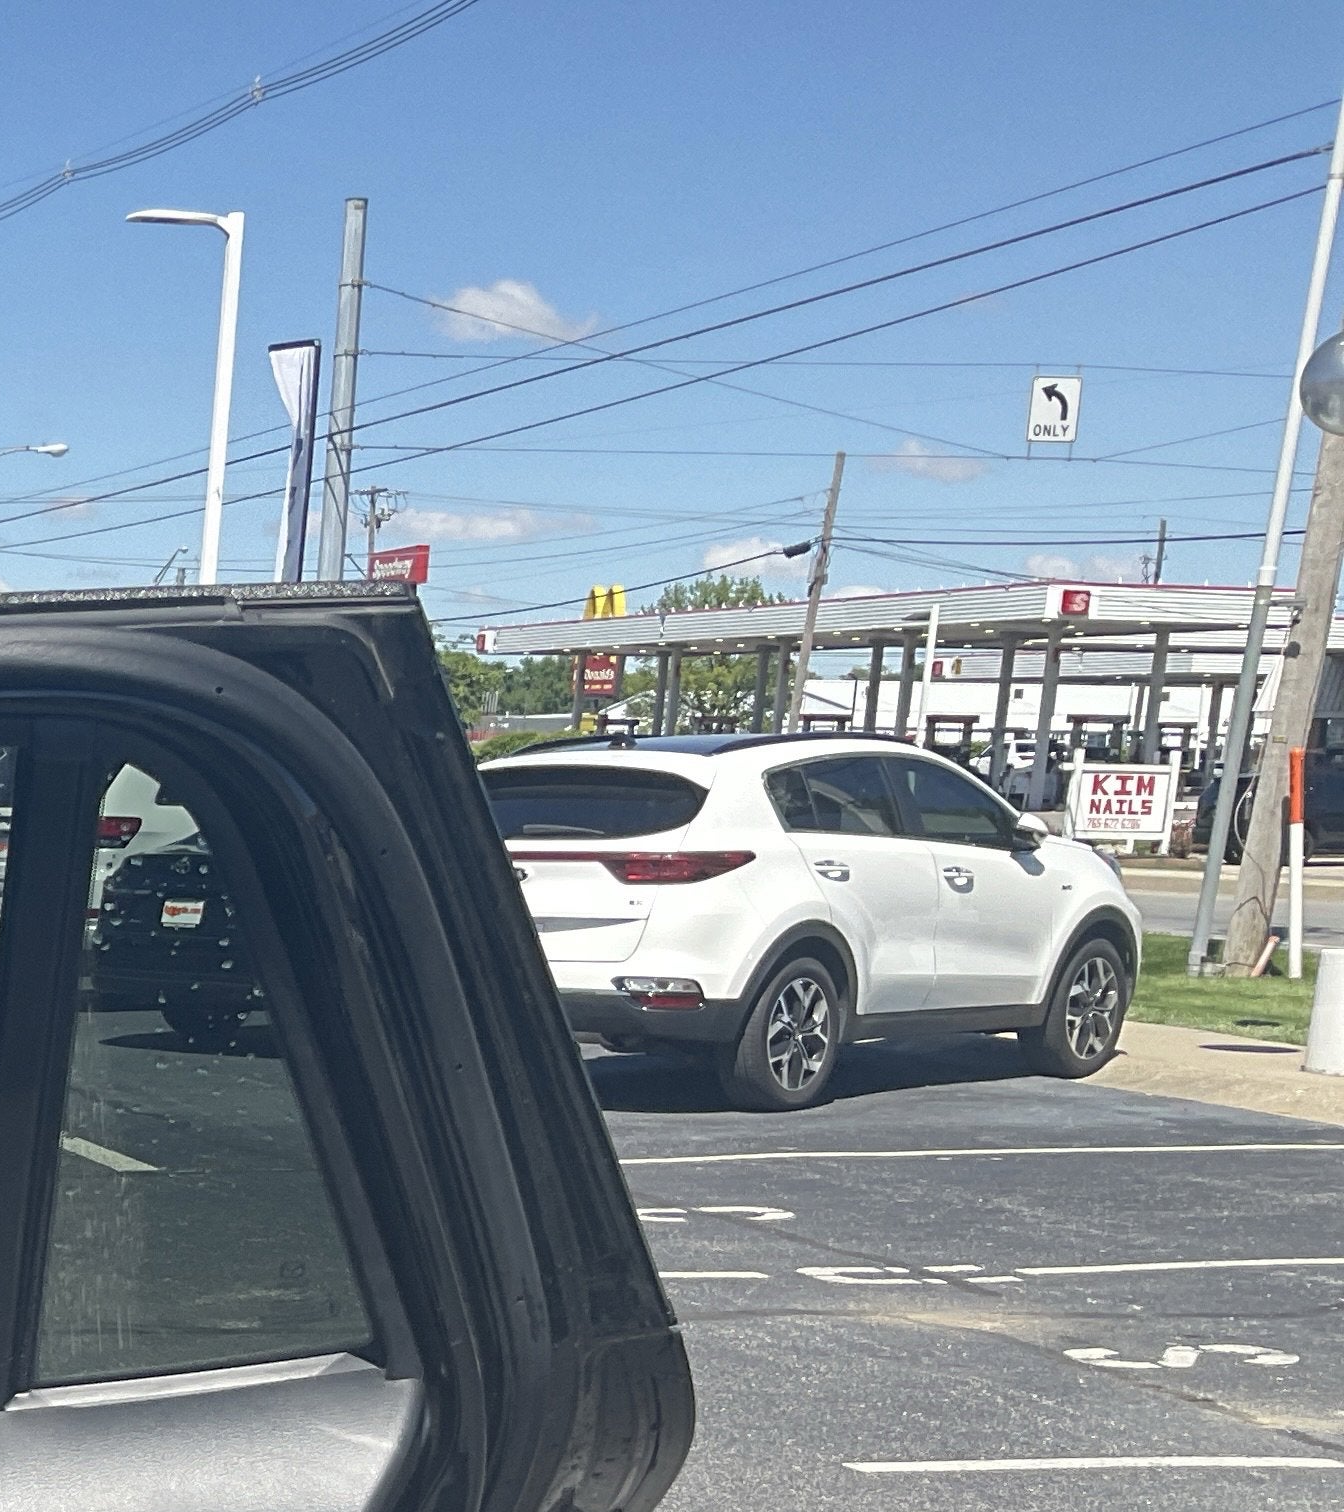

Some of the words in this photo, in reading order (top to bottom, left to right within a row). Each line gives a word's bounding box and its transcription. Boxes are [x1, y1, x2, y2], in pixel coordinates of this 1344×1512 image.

[1033, 424, 1070, 437] ONLY
[1091, 774, 1156, 796] KIM
[1089, 799, 1153, 815] NAILS
